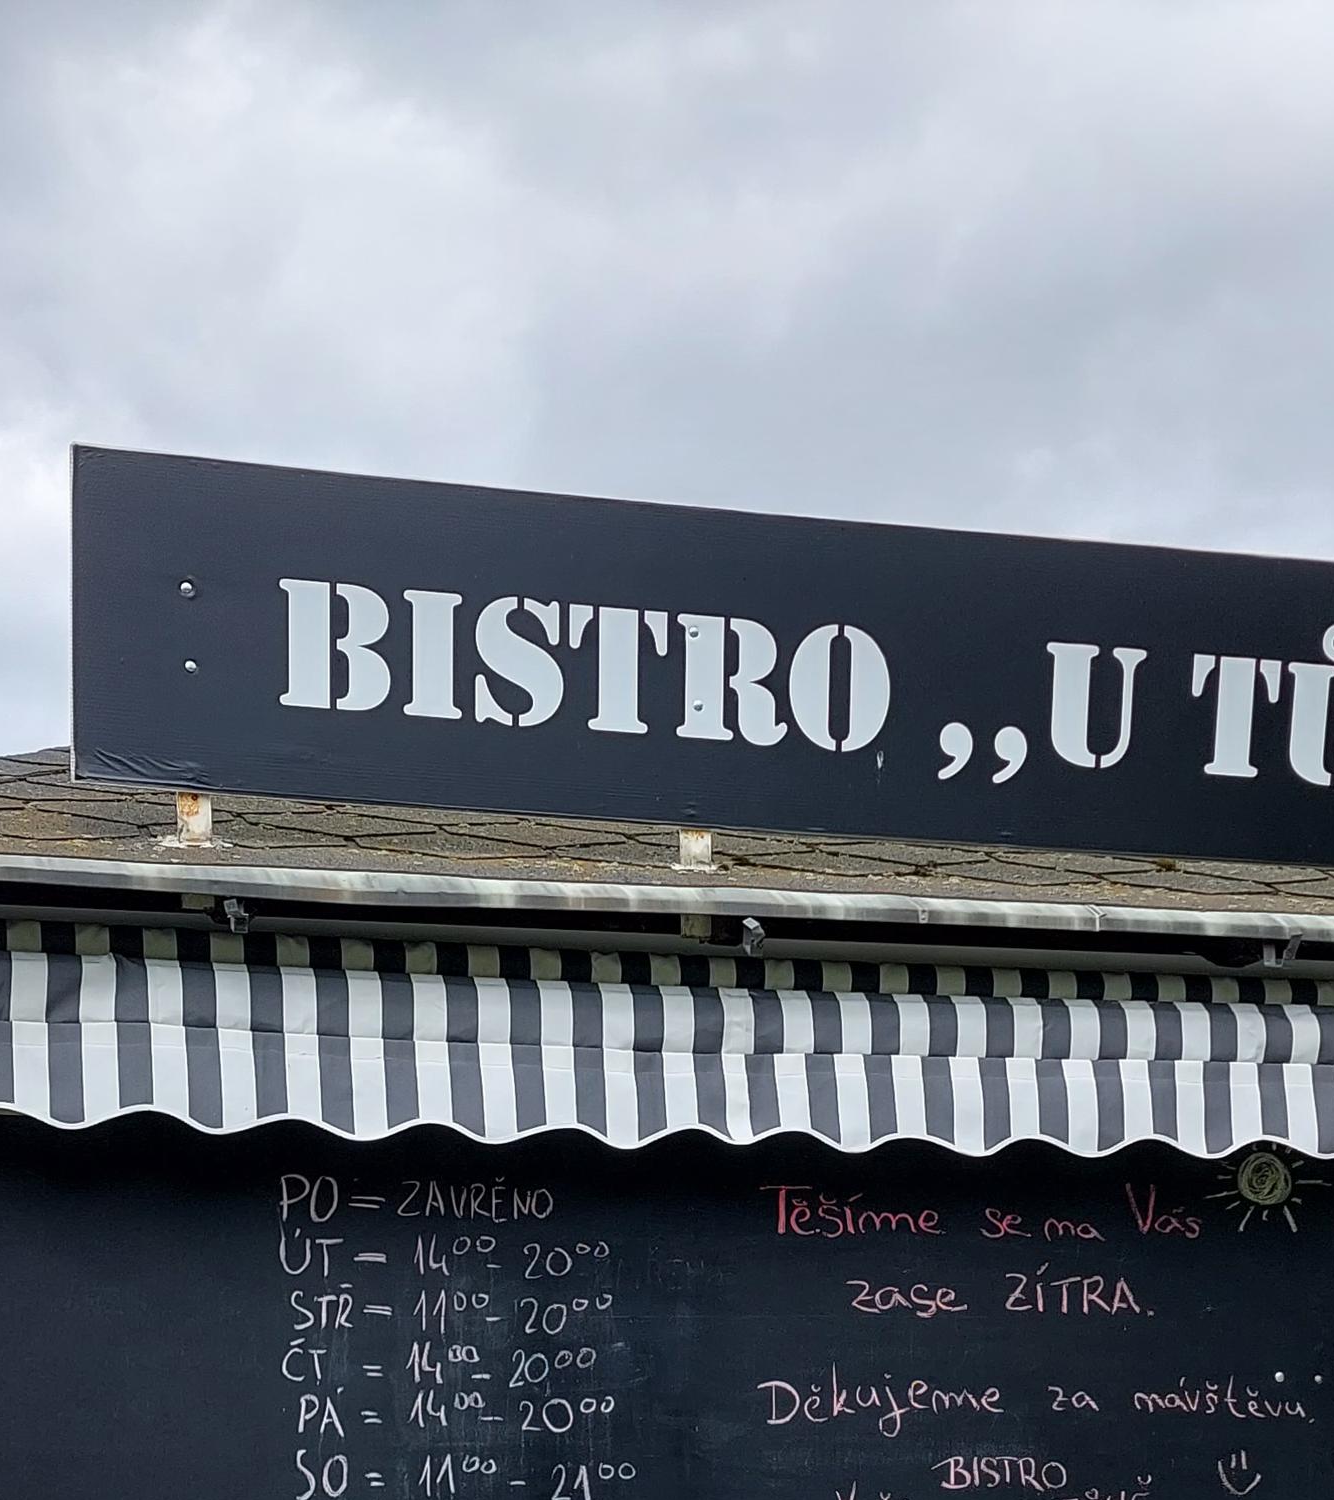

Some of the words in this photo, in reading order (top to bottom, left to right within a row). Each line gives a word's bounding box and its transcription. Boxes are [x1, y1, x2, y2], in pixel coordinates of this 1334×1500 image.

[277, 576, 892, 755] BISTRO
[280, 1174, 339, 1224] PO
[760, 1185, 943, 1236] Těšíme
[980, 1208, 1032, 1240] se
[1126, 1183, 1203, 1239] Vás
[280, 1228, 344, 1276] ÚT
[297, 1386, 345, 1438] PÁ
[757, 1361, 1005, 1438] Děkujeme
[1047, 1385, 1100, 1413] za
[295, 1450, 349, 1500] SO
[931, 1456, 1068, 1492] BISTRO
